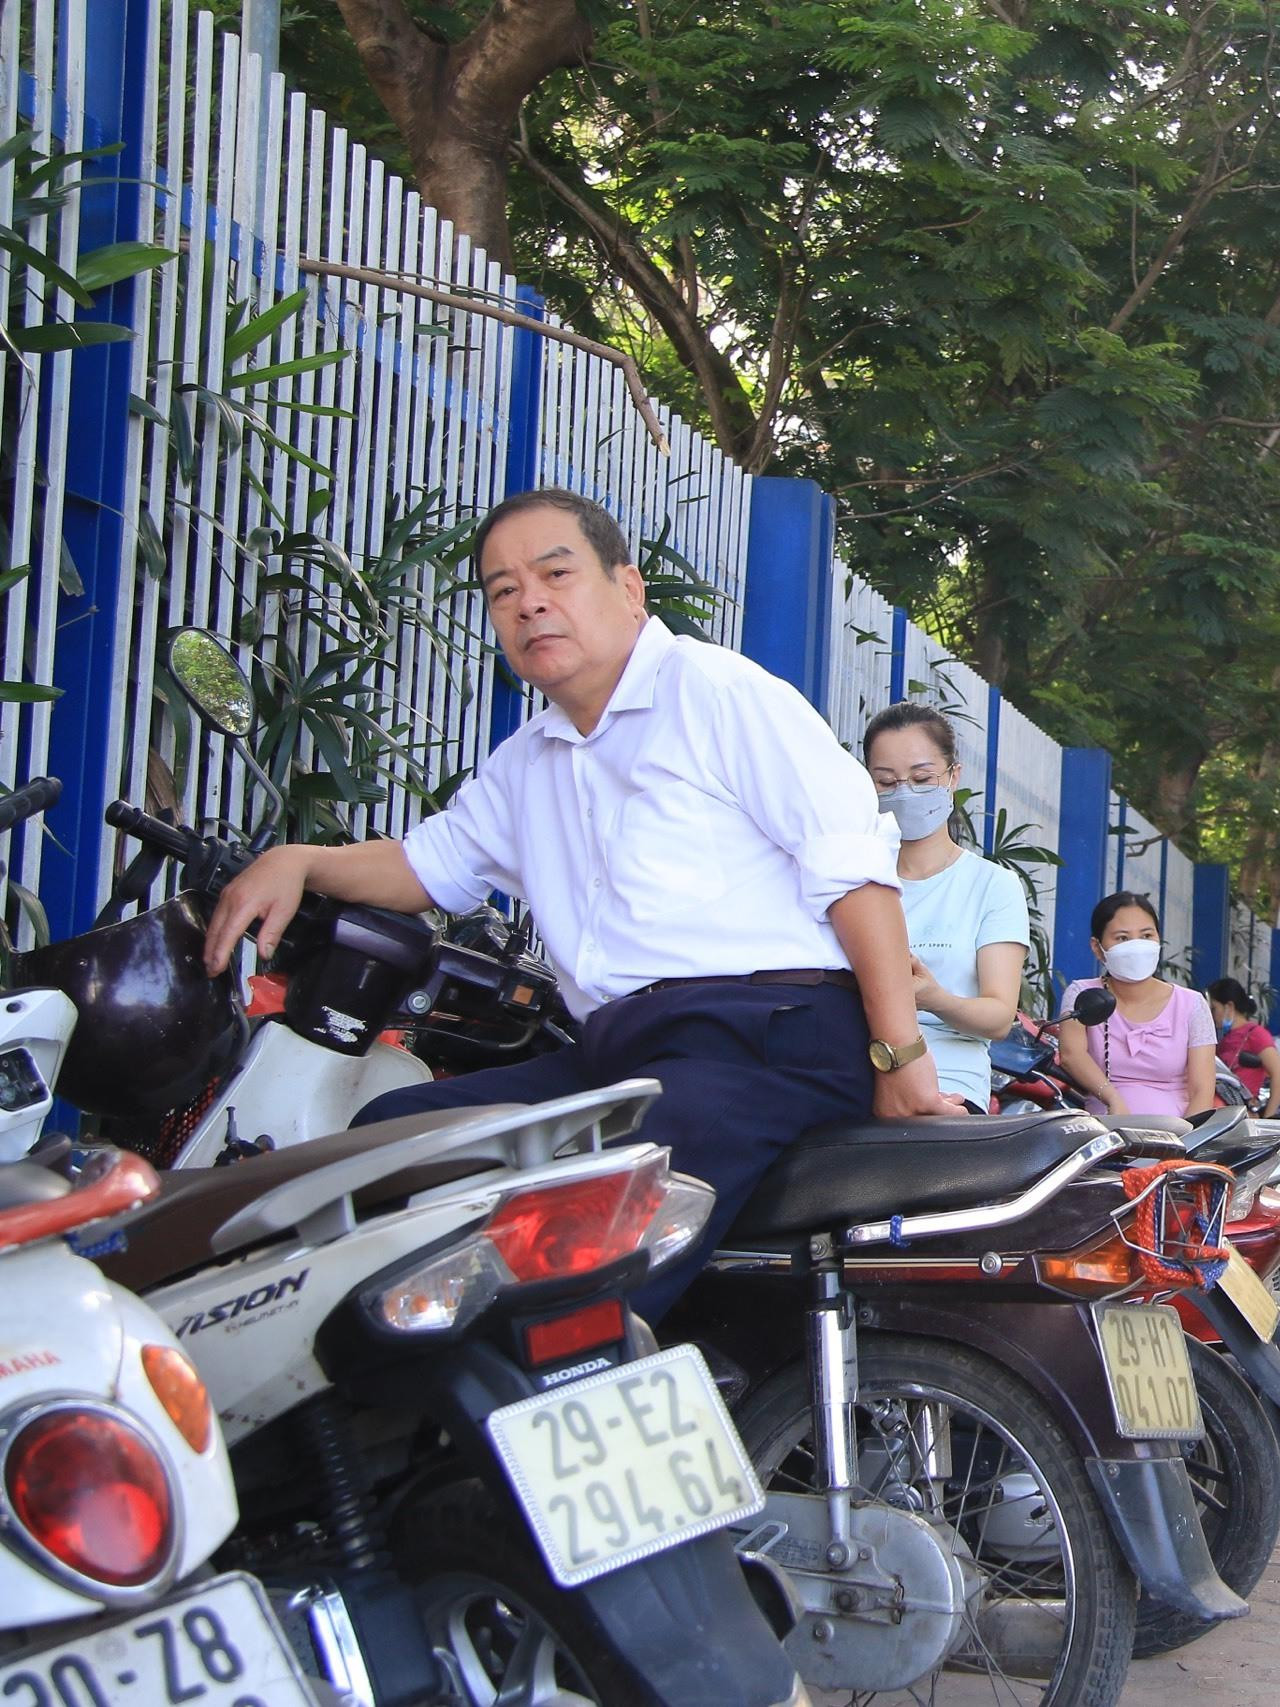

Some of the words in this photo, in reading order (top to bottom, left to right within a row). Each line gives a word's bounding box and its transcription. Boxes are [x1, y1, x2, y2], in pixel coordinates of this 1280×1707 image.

[168, 1266, 311, 1339] VISION
[543, 1357, 613, 1387] HONDA
[1109, 1314, 1176, 1368] 29-H1
[532, 1370, 698, 1480] 29-E2
[1116, 1374, 1192, 1428] 041.07
[549, 1438, 743, 1565] 294.64
